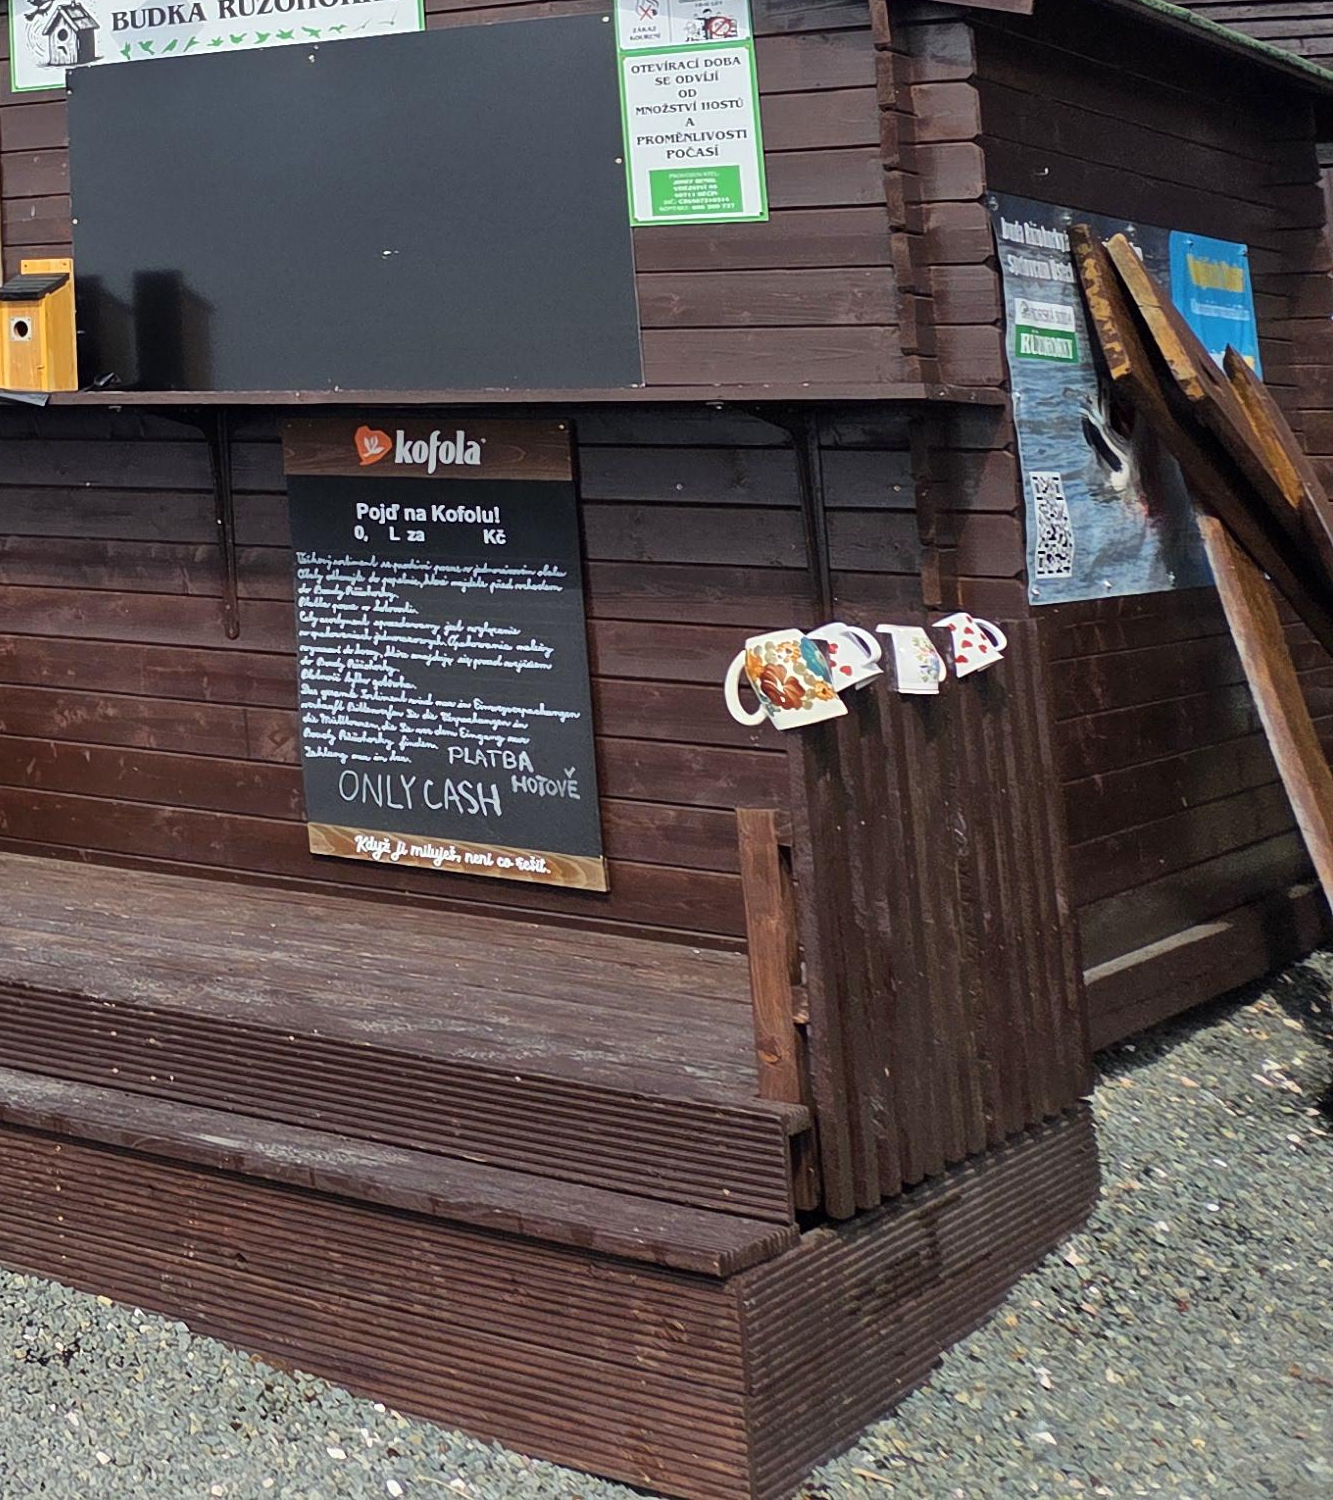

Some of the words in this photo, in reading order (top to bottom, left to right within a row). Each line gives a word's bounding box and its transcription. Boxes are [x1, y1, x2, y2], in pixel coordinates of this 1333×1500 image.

[112, 2, 208, 32] BUDKA
[631, 58, 700, 75] OTEVÍRACÍ
[704, 56, 741, 69] DOBA
[654, 78, 671, 86] SE
[675, 71, 720, 85] ODVÍJÍ
[677, 88, 697, 99] OD
[635, 102, 697, 117] MNOŽSTVÍ
[701, 97, 745, 112] HOSTŮ
[685, 117, 696, 127] A
[636, 129, 748, 147] PROMĚNLIVOSTI
[666, 144, 720, 160] POČASÍ
[394, 430, 482, 475] kofola
[356, 502, 401, 524] Pojď
[404, 507, 427, 522] na
[431, 504, 501, 524] Kofolu!
[389, 526, 401, 541] L
[406, 529, 426, 542] za
[483, 528, 507, 545] Kč
[447, 746, 535, 773] PLATBA
[511, 767, 582, 800] HOTOVĚ
[339, 770, 416, 811] ONLY
[423, 778, 503, 818] CASH
[354, 834, 392, 861] Když
